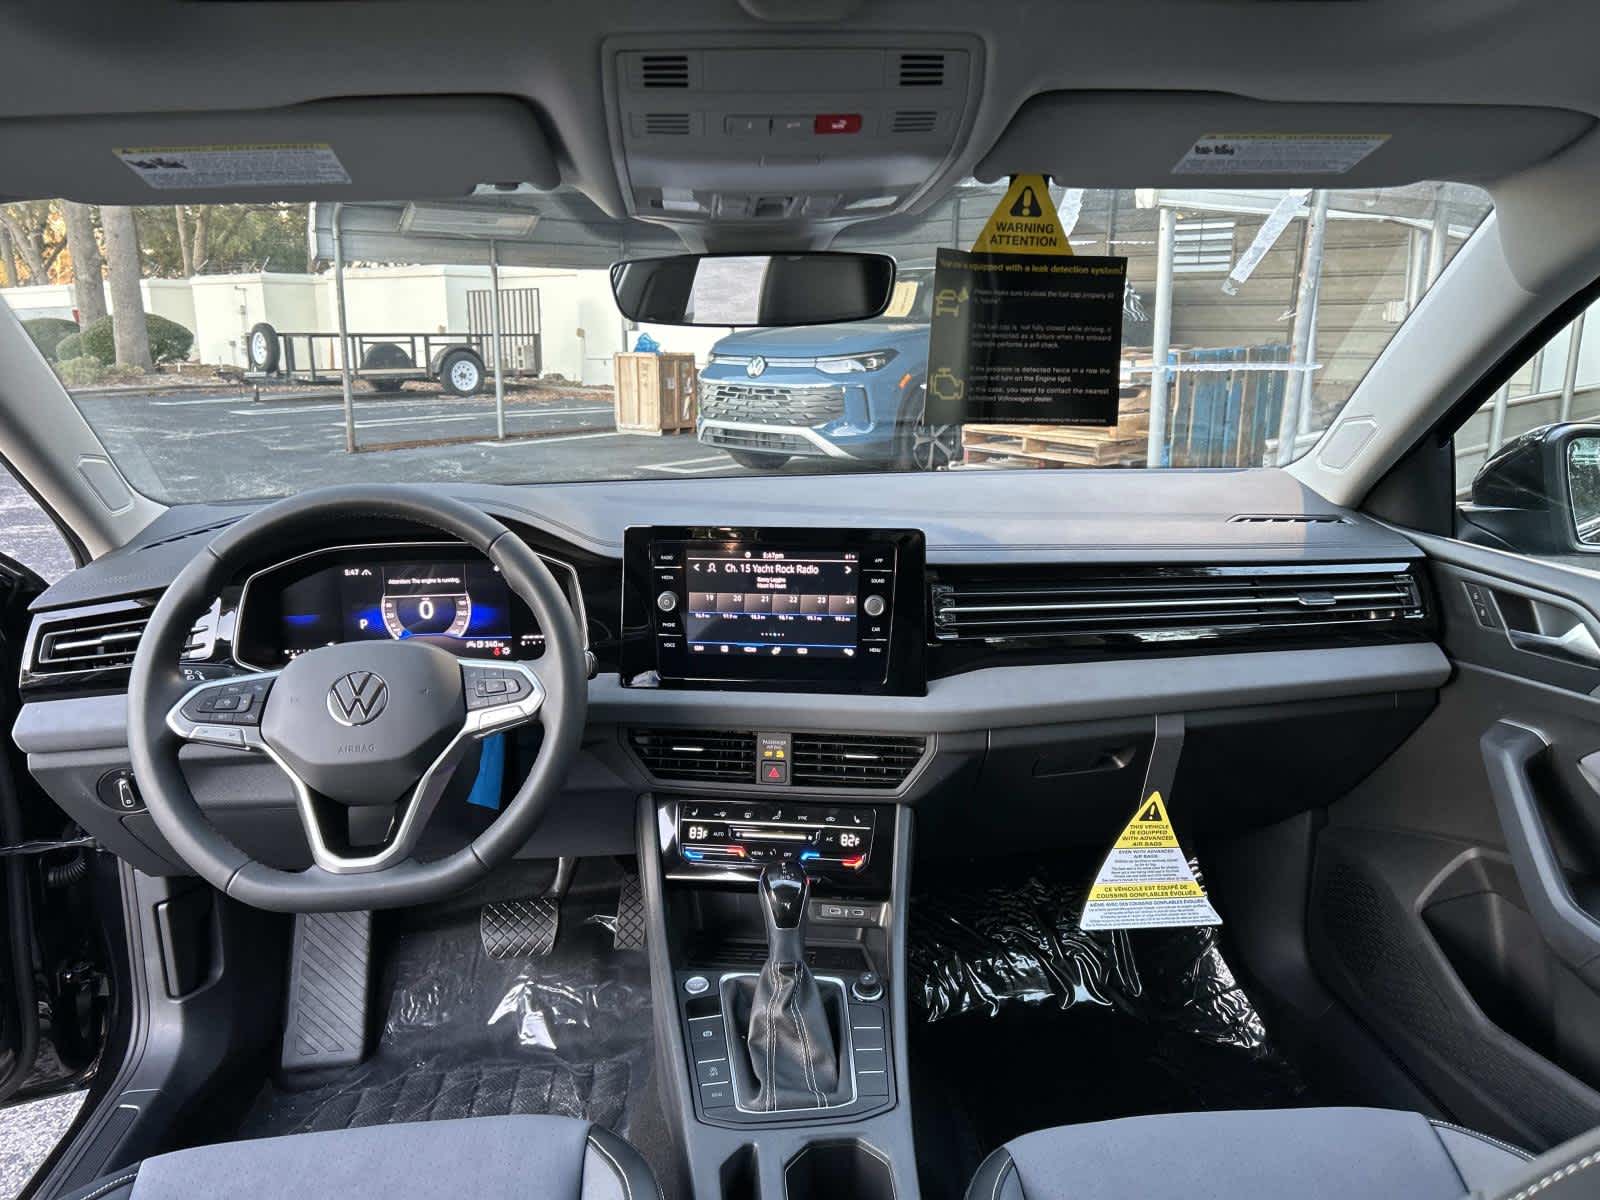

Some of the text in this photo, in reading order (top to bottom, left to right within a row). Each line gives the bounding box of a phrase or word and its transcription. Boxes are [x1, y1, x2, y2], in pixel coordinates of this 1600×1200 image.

[995, 222, 1054, 234] WARNING
[990, 234, 1057, 247] ATTENTION
[1005, 263, 1023, 272] with
[1032, 264, 1049, 273] leak
[1051, 265, 1089, 274] detection
[1091, 265, 1124, 276] system!
[1035, 375, 1057, 383] Engine
[1006, 387, 1018, 395] you
[1046, 387, 1071, 395] contact
[725, 563, 820, 575] Ch. 15 Yacht Rock Radio
[419, 600, 434, 620] 0
[359, 618, 368, 630] P
[336, 743, 376, 754] AIRBAG
